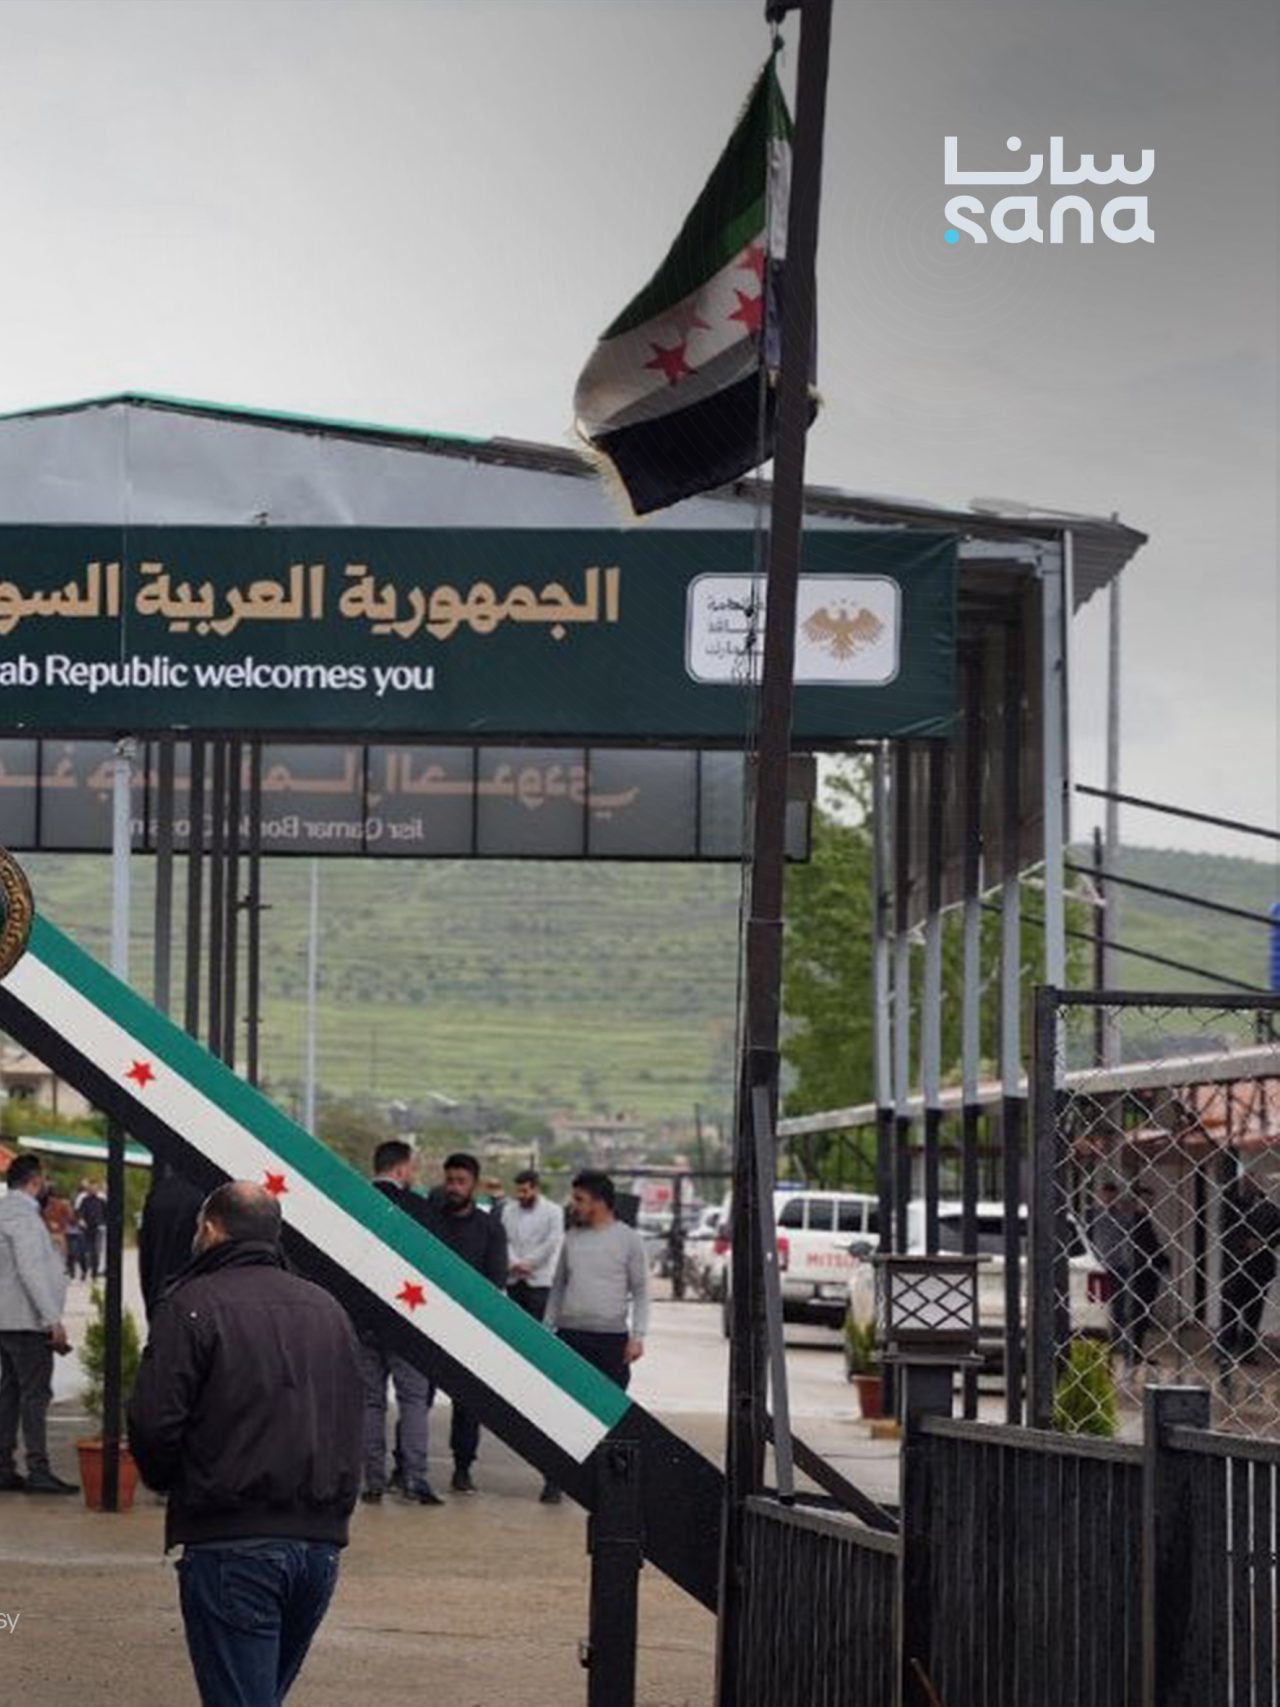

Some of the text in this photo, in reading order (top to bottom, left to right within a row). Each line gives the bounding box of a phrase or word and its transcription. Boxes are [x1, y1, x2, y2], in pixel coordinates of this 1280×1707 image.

[136, 562, 324, 635] العربية
[341, 565, 619, 640] الجمهورية
[45, 654, 188, 694] Republic
[194, 656, 367, 690] welcomes
[373, 665, 434, 697] you
